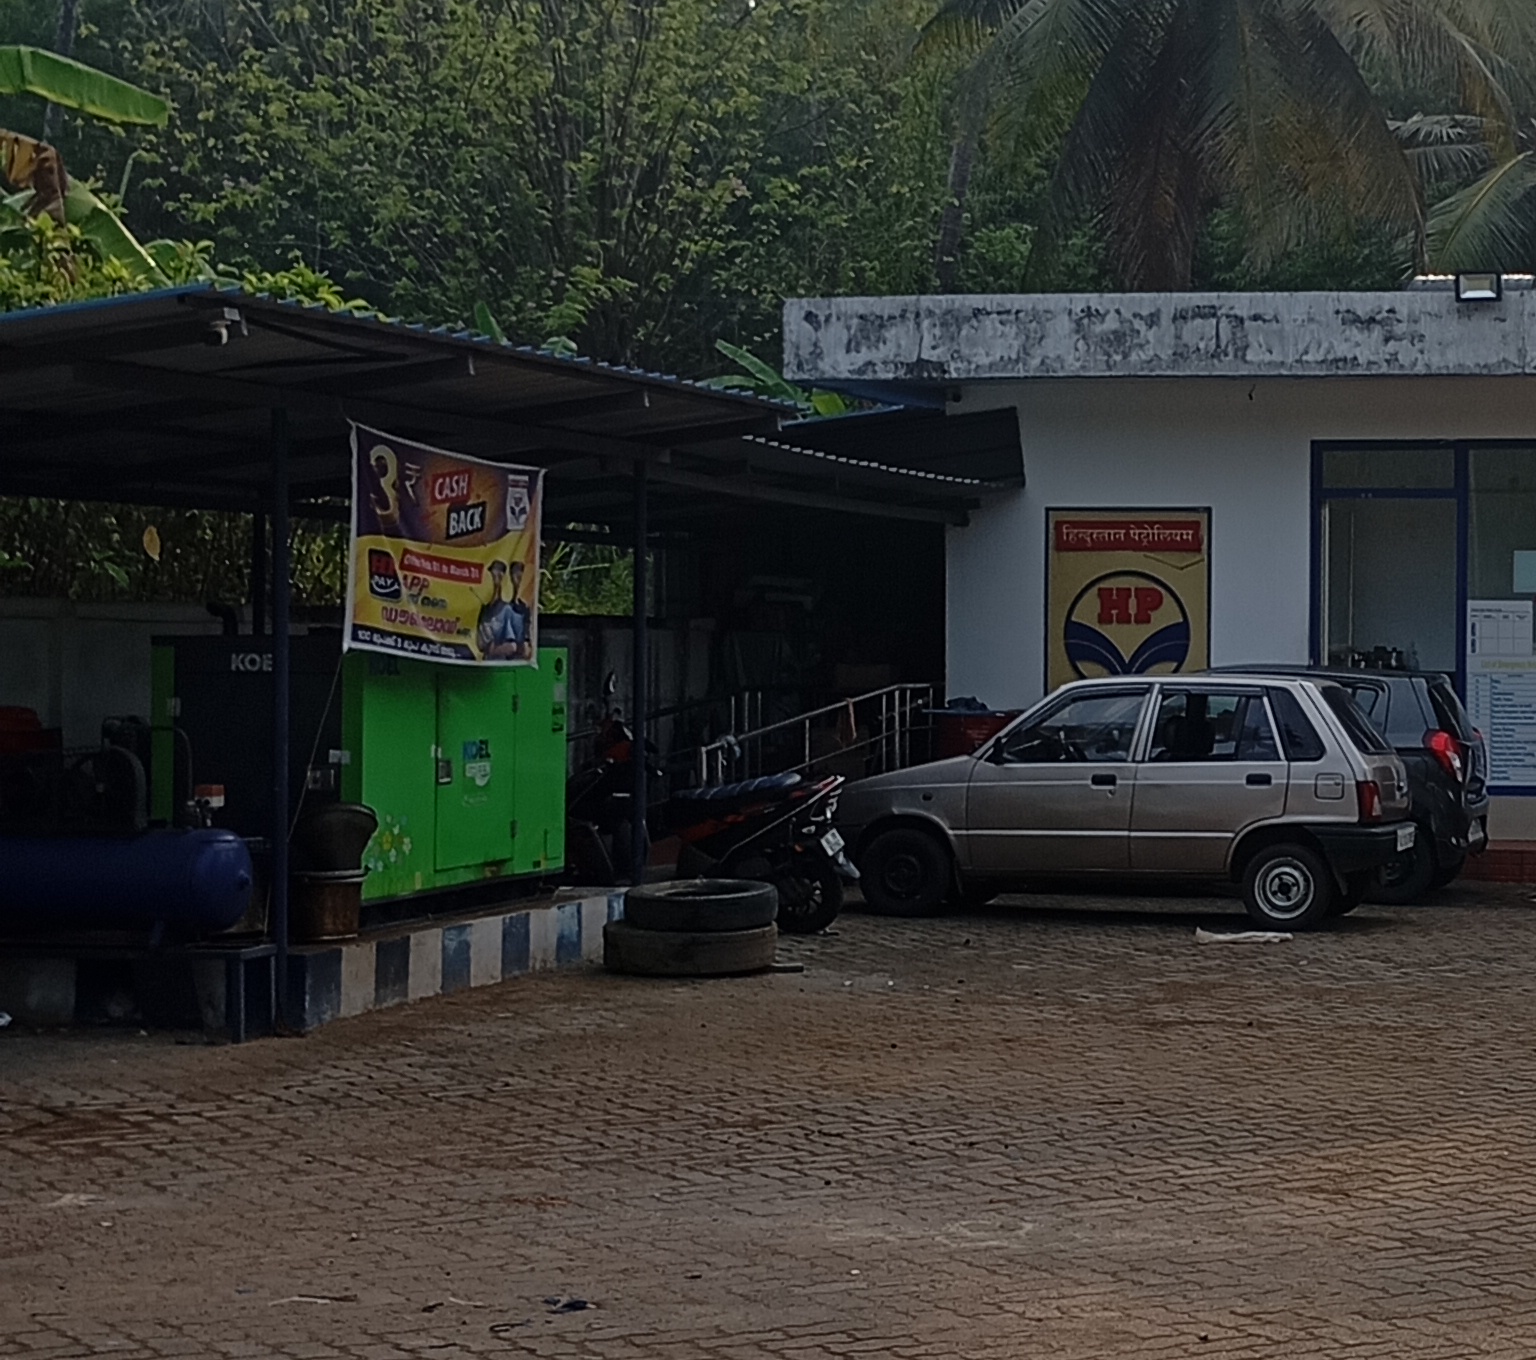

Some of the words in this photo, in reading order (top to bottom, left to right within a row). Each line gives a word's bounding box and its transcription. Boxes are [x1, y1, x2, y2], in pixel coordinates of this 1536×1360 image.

[434, 473, 469, 500] CASH
[449, 506, 484, 536] BACK
[1062, 524, 1126, 547] हिन्दुस्तान
[1129, 524, 1194, 546] पेट्रोलियम
[373, 574, 394, 586] PAY
[1097, 587, 1164, 625] HP
[231, 652, 273, 672] KOE
